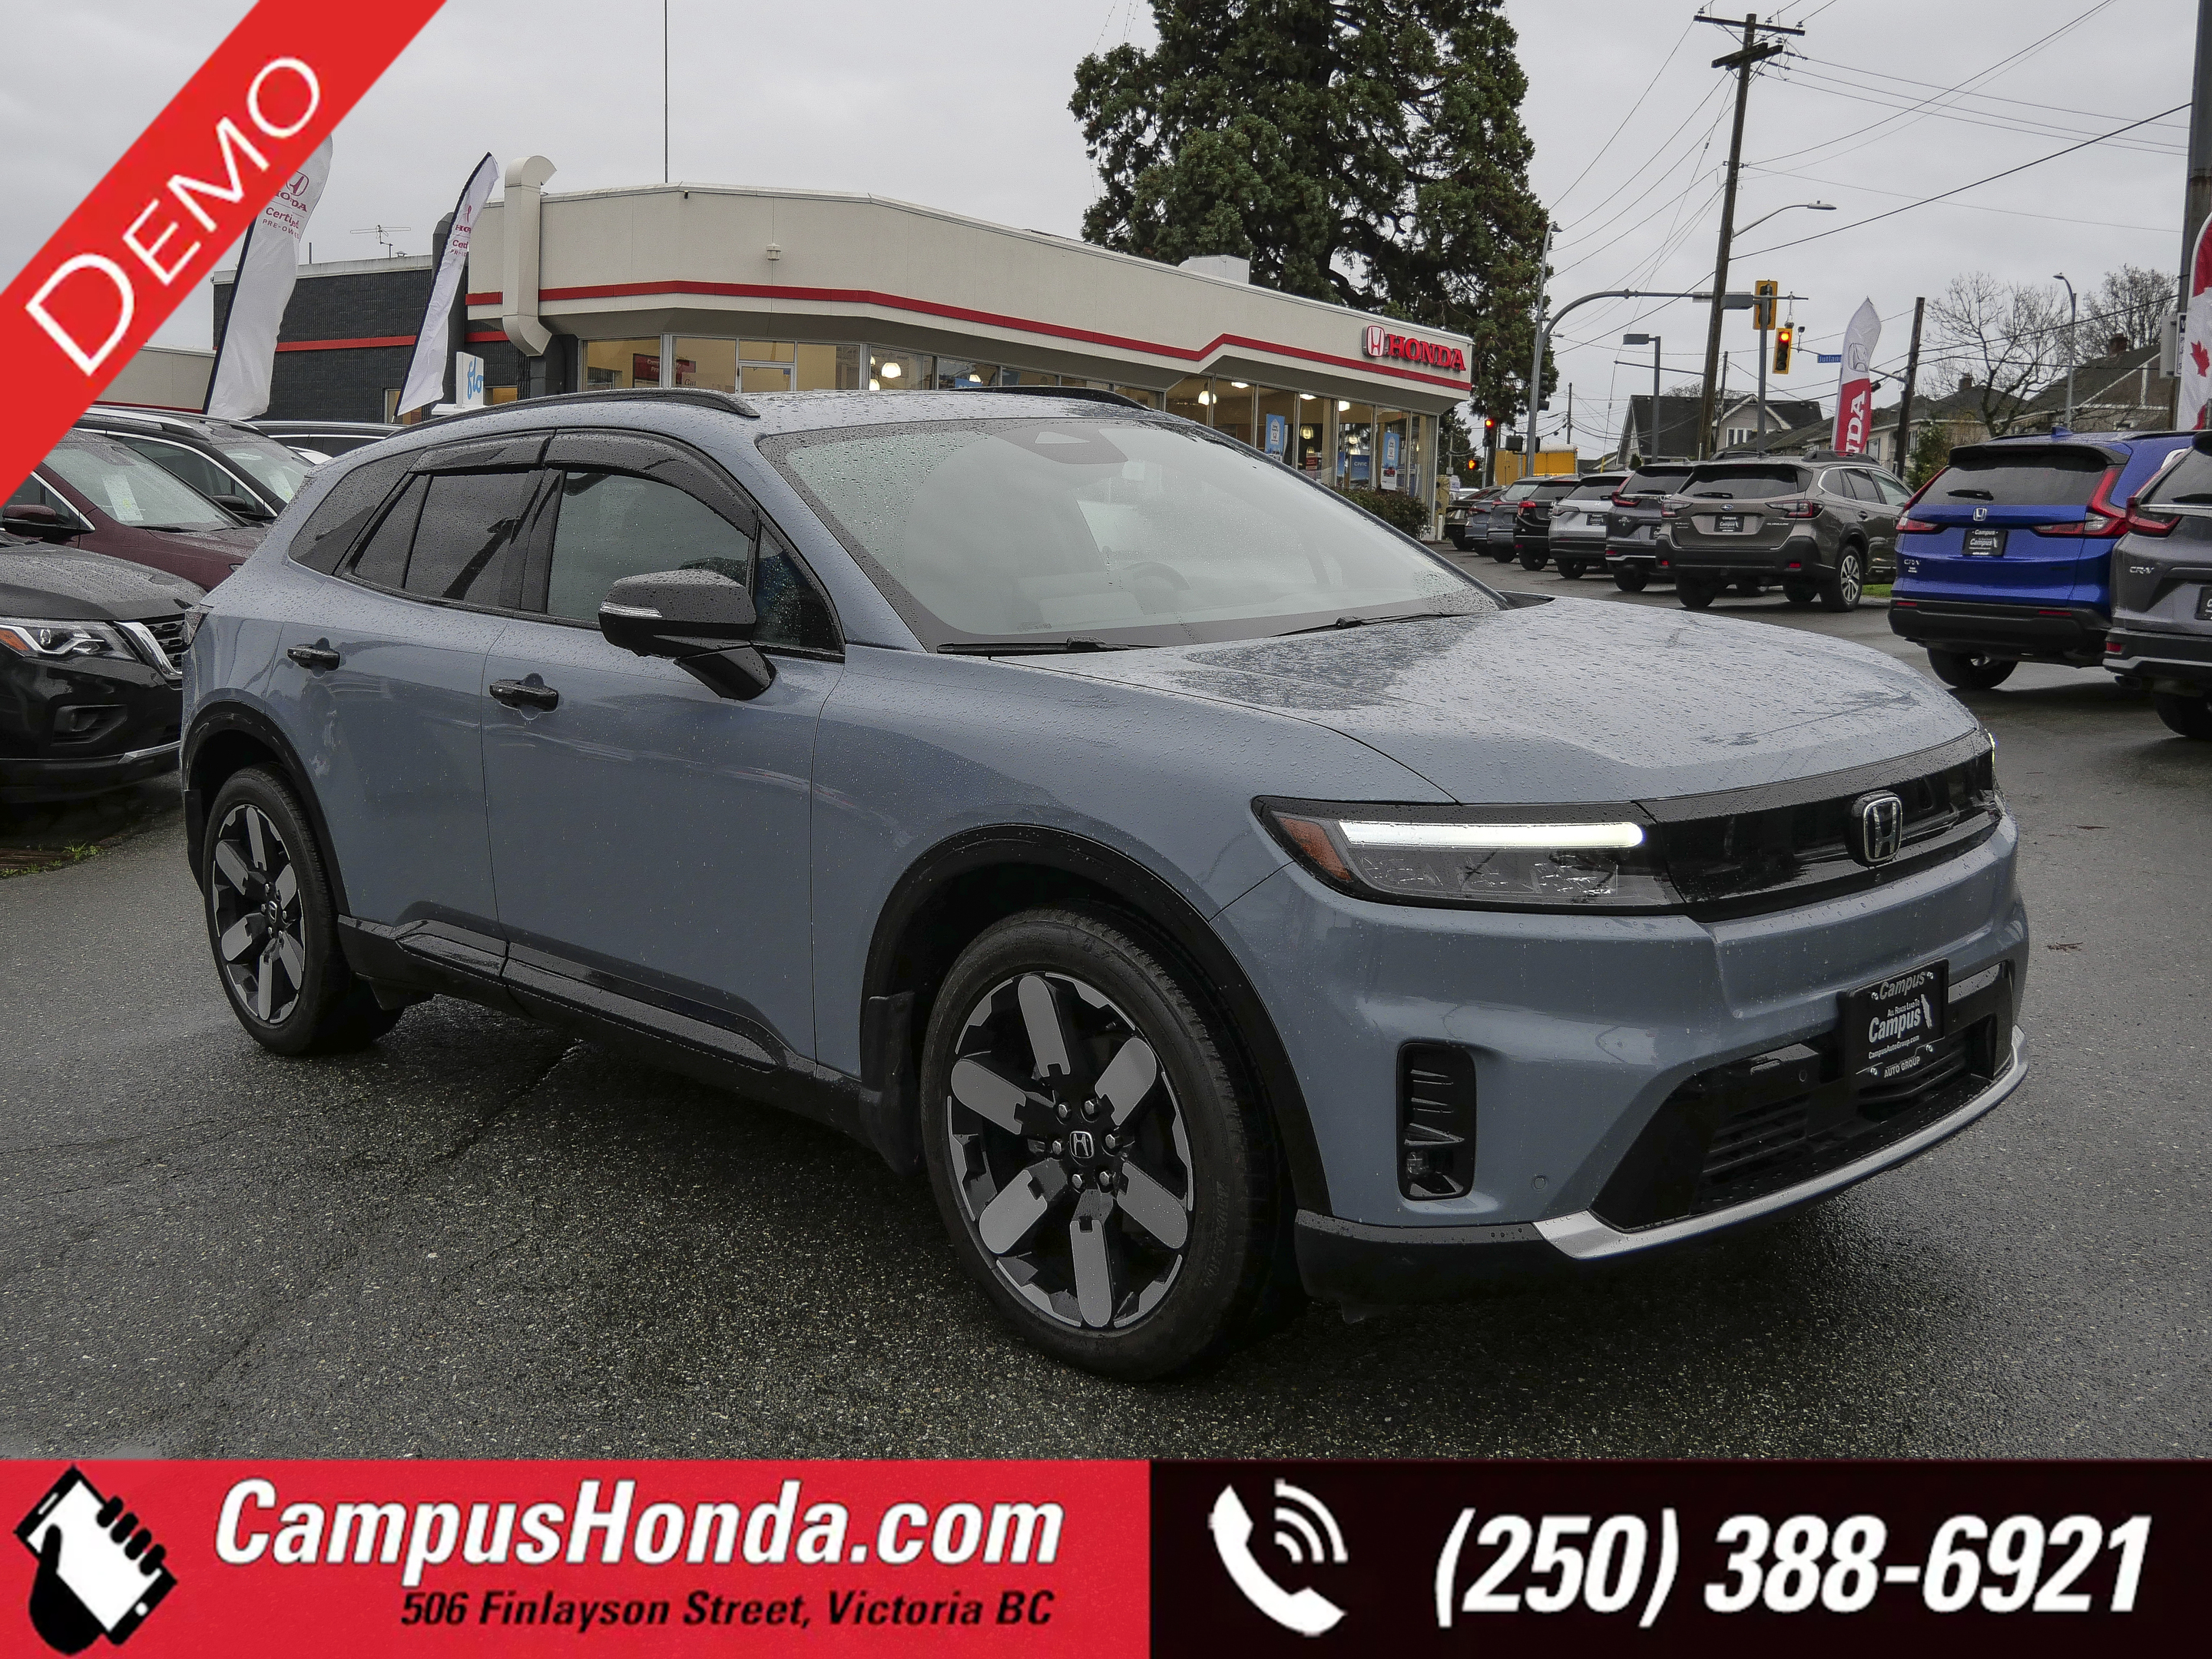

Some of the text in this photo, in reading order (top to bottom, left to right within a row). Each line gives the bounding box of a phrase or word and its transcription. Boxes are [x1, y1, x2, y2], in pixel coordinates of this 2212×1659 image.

[275, 190, 307, 212] ODA
[1387, 334, 1467, 371] HONDA
[467, 357, 484, 399] flo
[1970, 538, 1993, 547] Campus
[2130, 566, 2155, 575] CR-V
[1879, 972, 1926, 1000] Campus
[1868, 1008, 1921, 1043] Campus
[1868, 1035, 1919, 1060] CampusAutoGroup.com
[1884, 1055, 1920, 1078] AUTO GROUP
